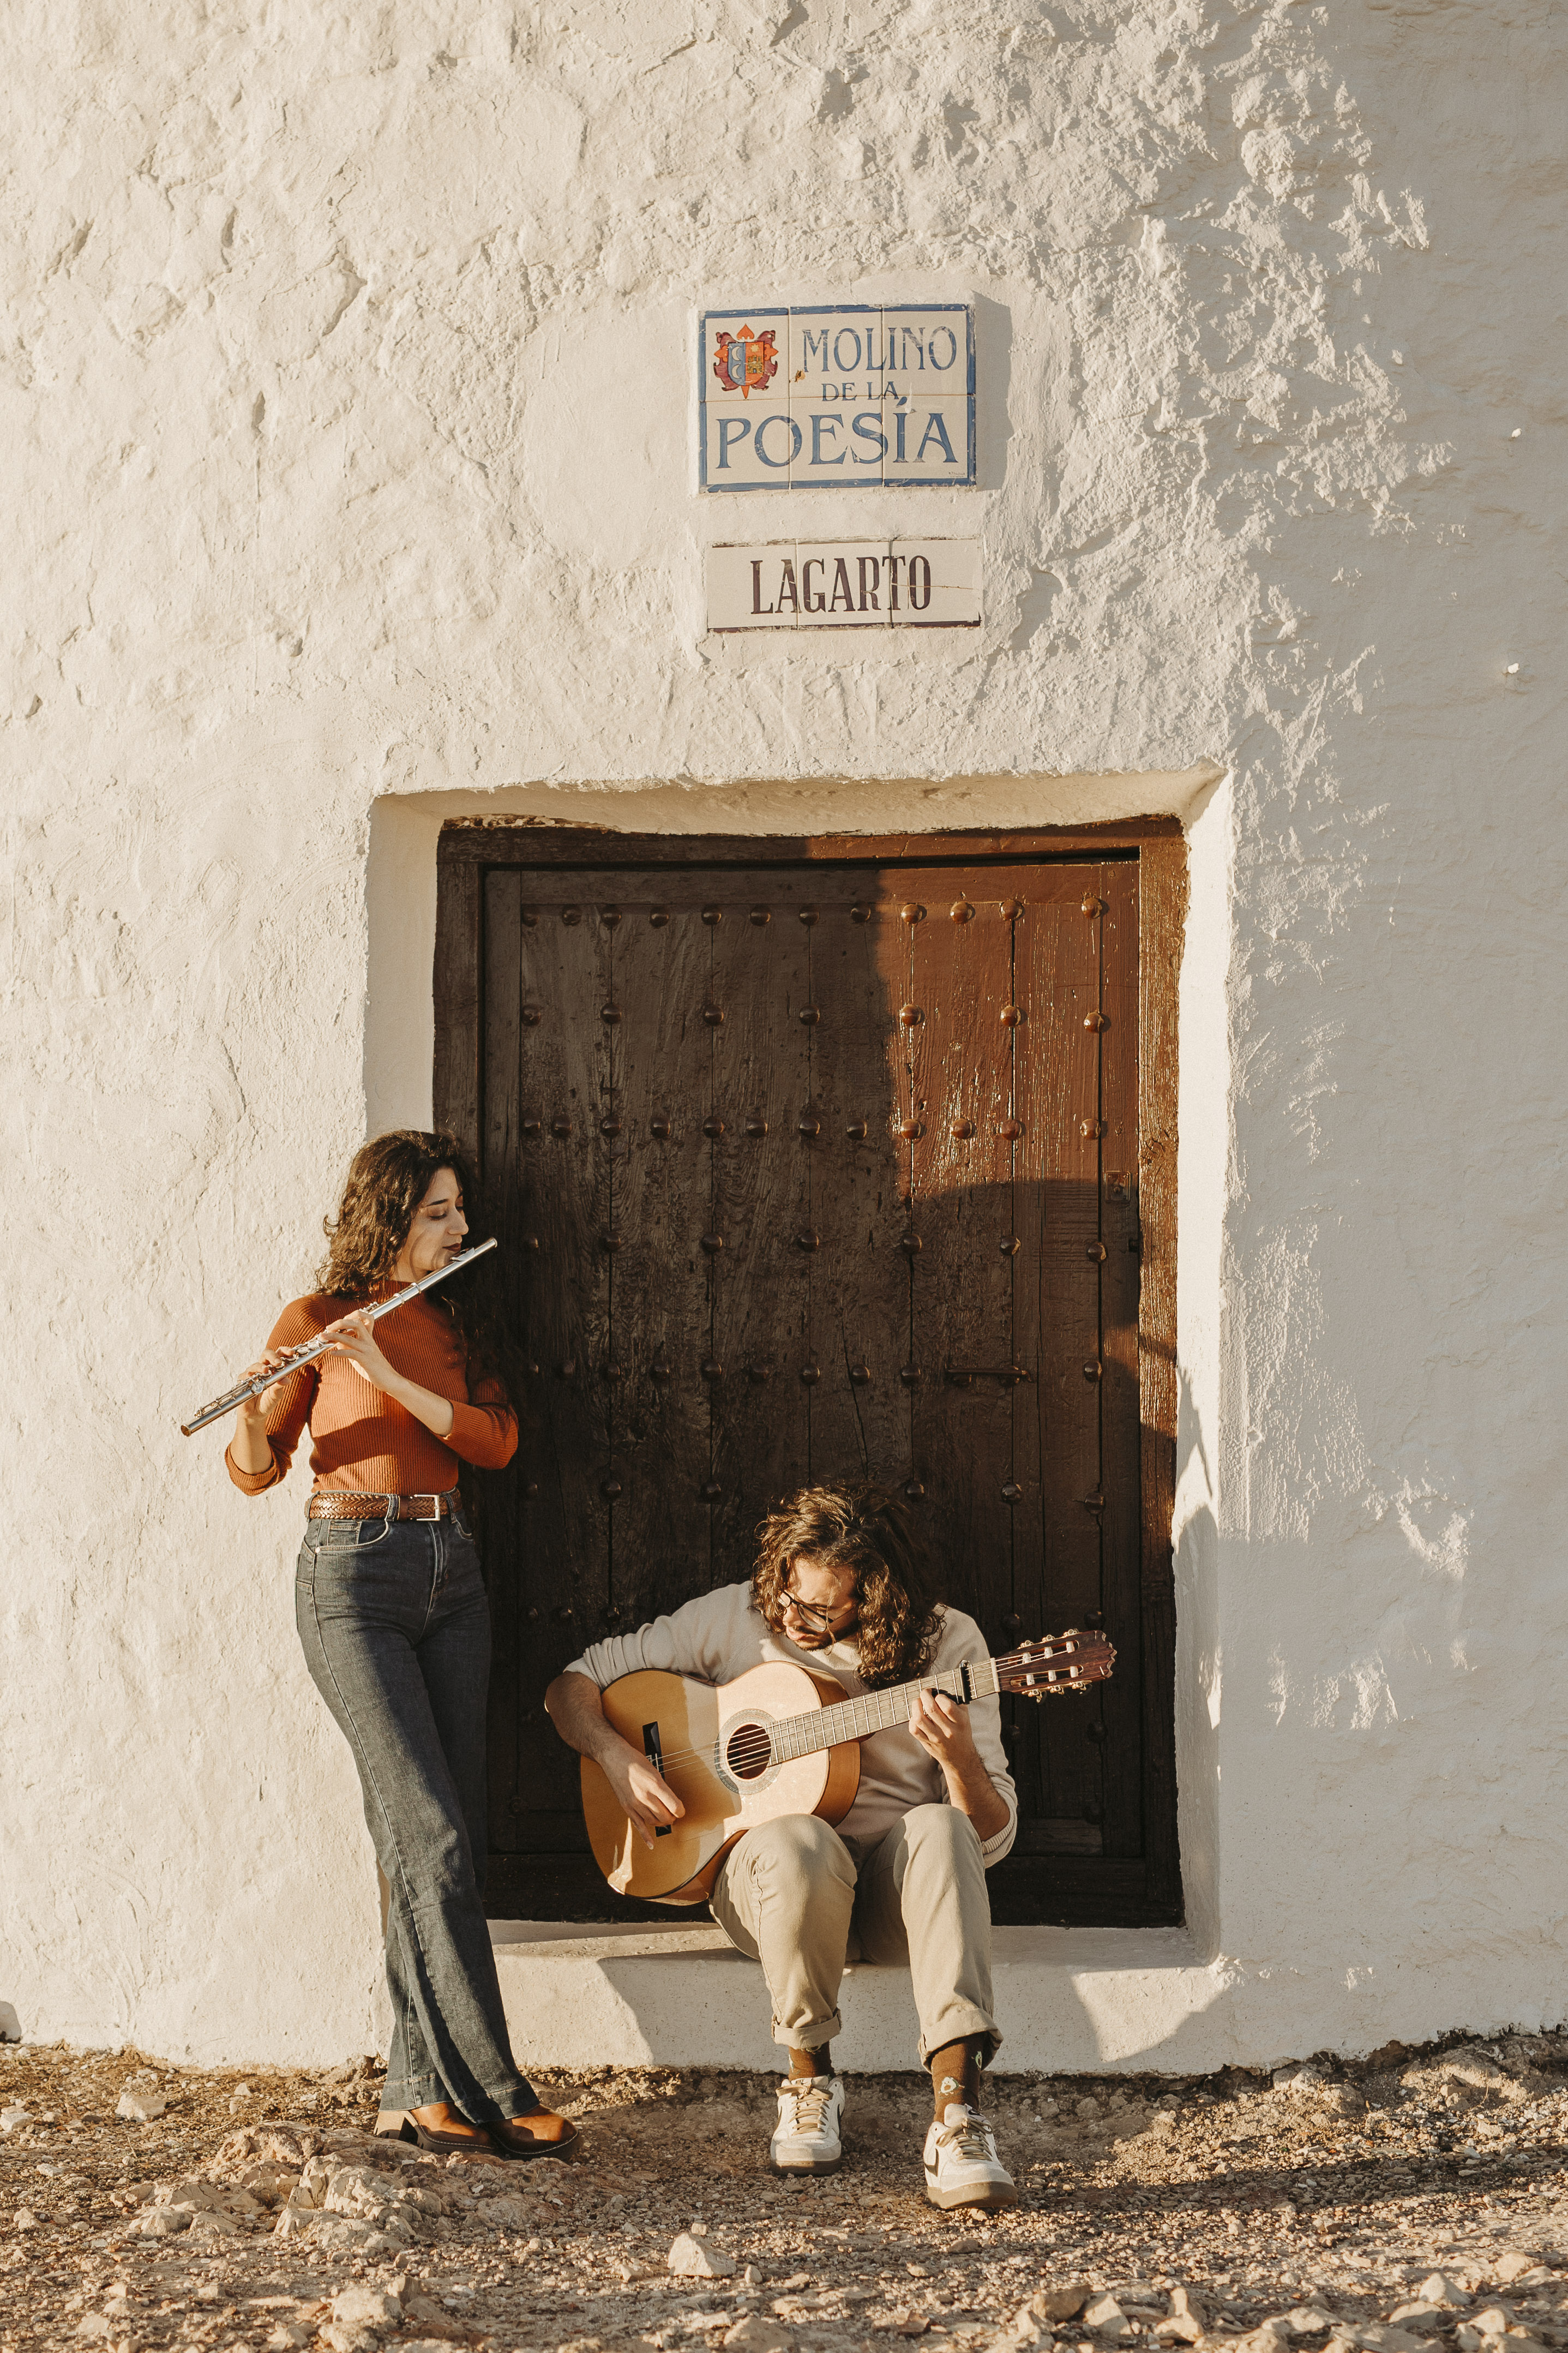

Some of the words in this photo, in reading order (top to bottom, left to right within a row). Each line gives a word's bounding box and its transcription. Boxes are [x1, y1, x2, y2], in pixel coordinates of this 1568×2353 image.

[802, 326, 957, 372] MOLINO
[822, 382, 857, 402] DE
[867, 381, 900, 401] LA
[716, 397, 959, 469] POESÍA
[750, 555, 932, 614] LAGARTO
